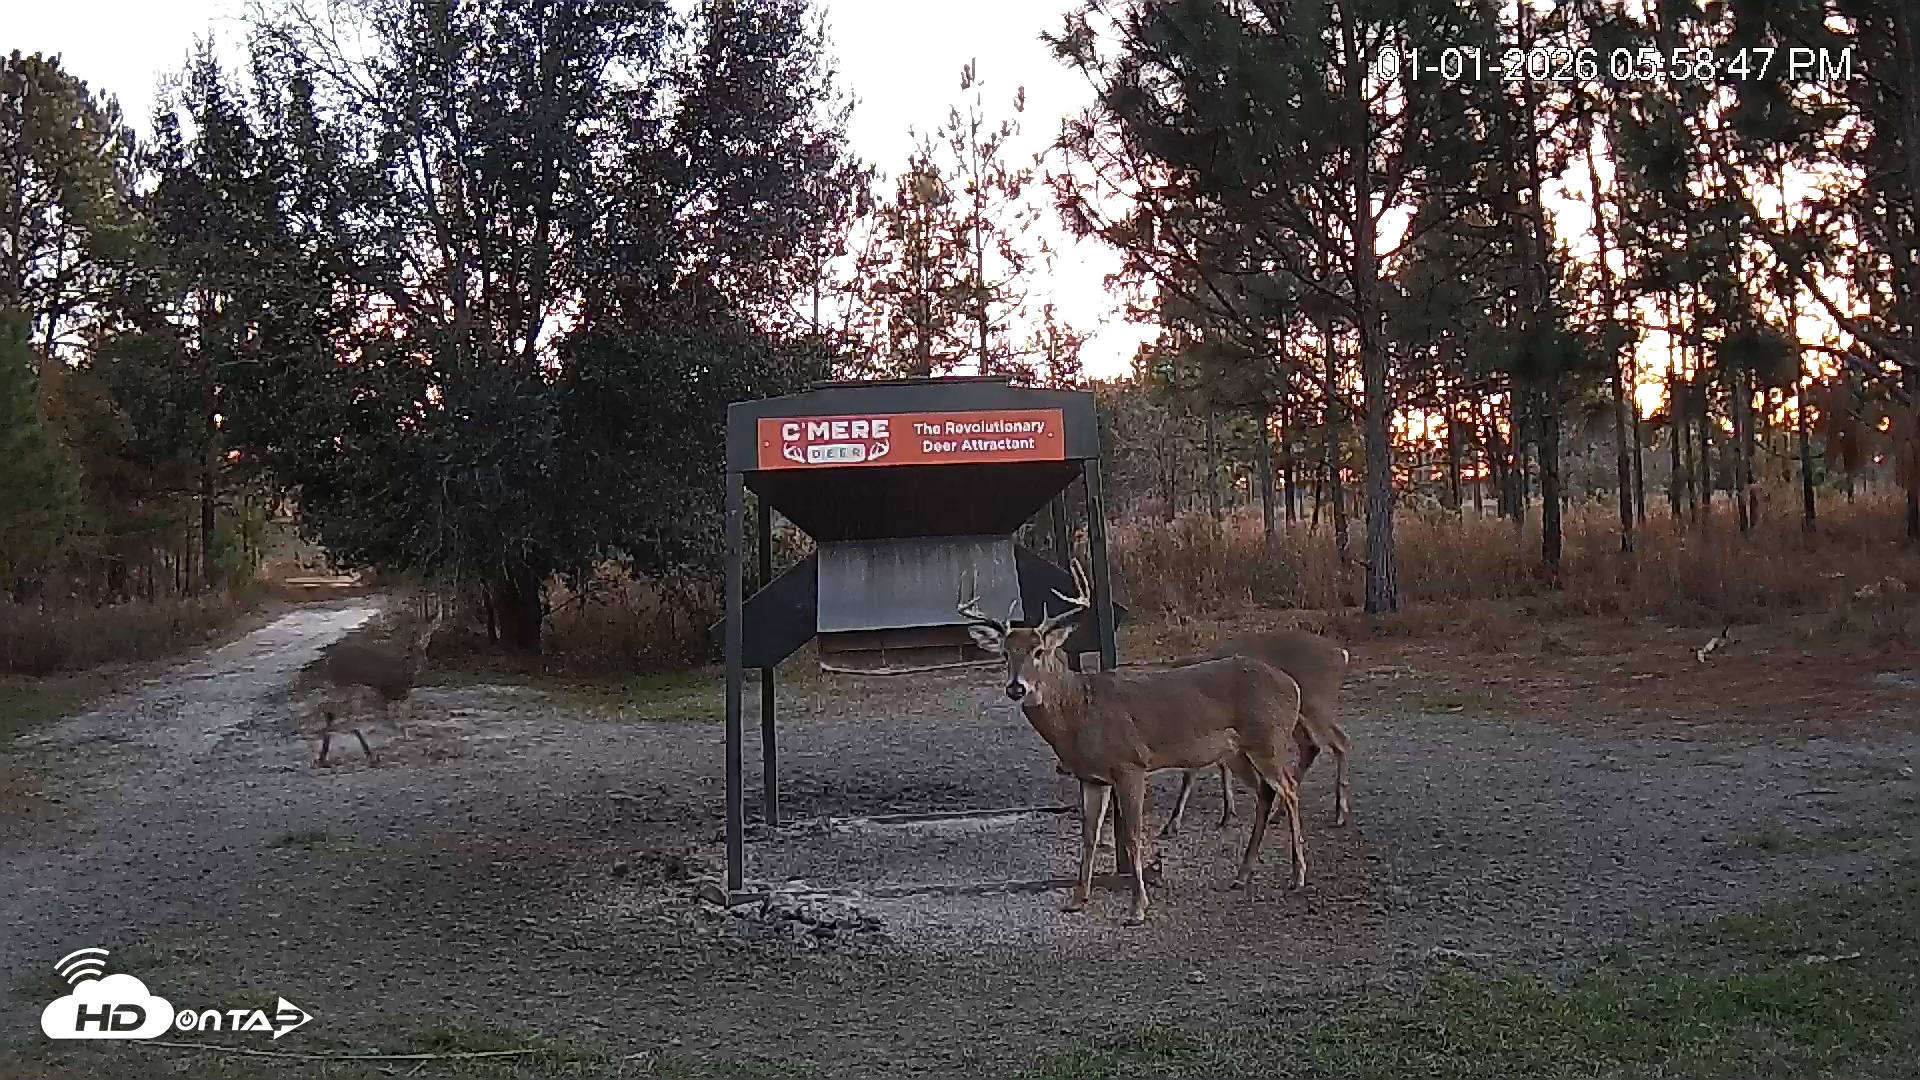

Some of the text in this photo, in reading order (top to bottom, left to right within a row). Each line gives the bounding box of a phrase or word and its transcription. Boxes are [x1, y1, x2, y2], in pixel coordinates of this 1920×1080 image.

[781, 419, 890, 441] C'MERE
[913, 419, 1045, 435] The Revolutionary
[811, 447, 861, 459] DEER
[922, 437, 1035, 453] Deer Attractant
